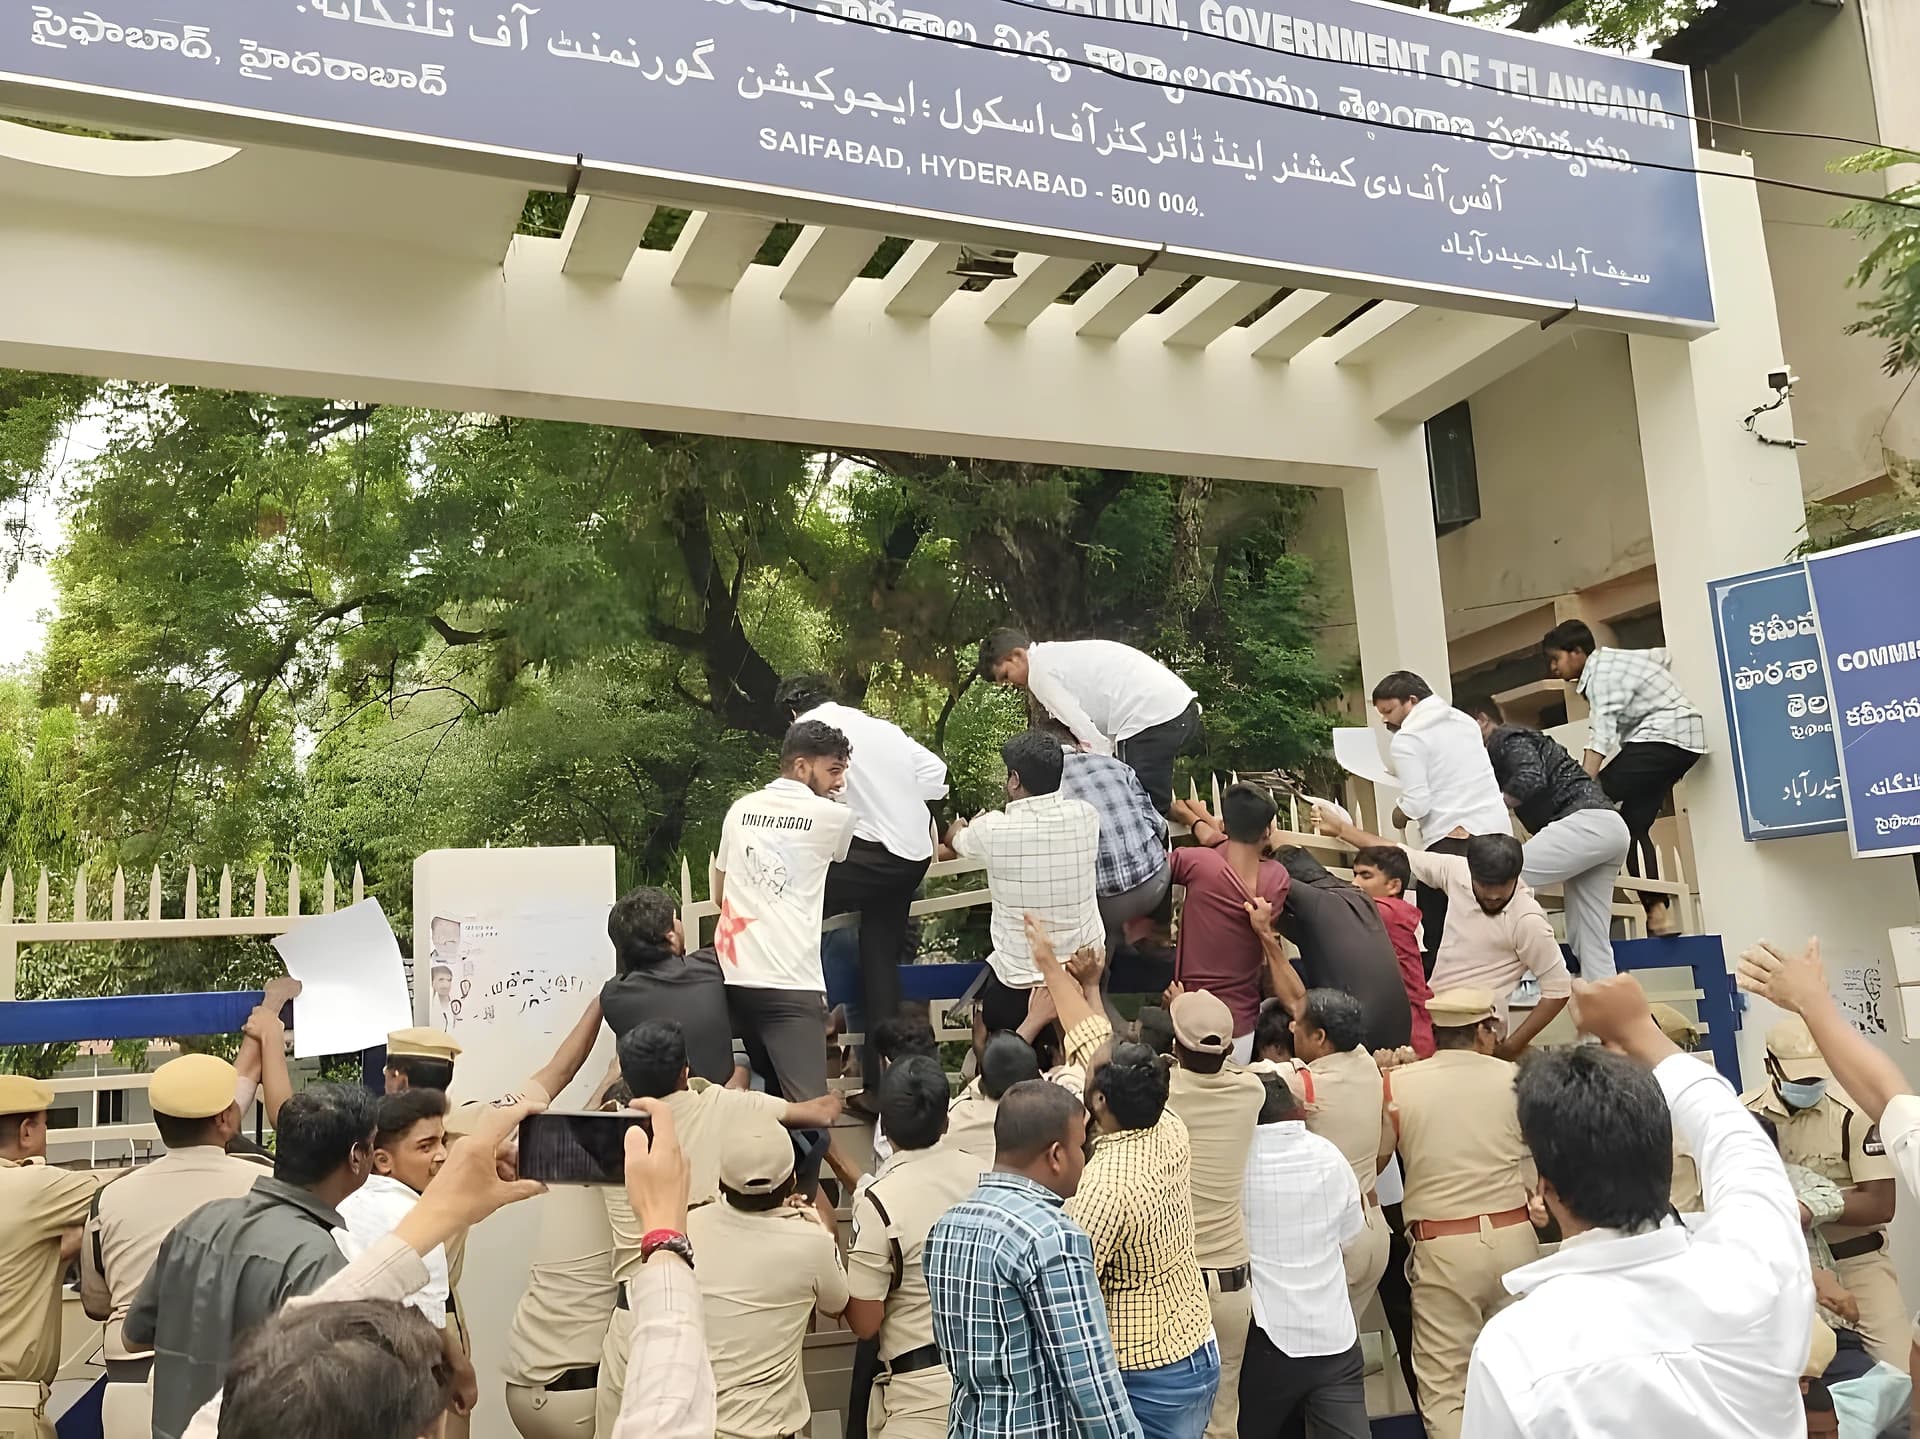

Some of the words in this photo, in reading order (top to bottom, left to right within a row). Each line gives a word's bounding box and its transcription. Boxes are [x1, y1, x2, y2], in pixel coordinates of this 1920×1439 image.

[468, 2, 541, 51] آف
[547, 30, 716, 86] گورنمنٹ
[1200, 0, 1429, 79] GOVERNMENT
[1440, 50, 1480, 89] OF
[1489, 59, 1675, 130] TELANGANA.
[758, 127, 912, 175] SAIFABAD,
[920, 152, 1088, 199] HYDERABAD
[1111, 184, 1150, 209] 500
[1406, 163, 1450, 203] آف
